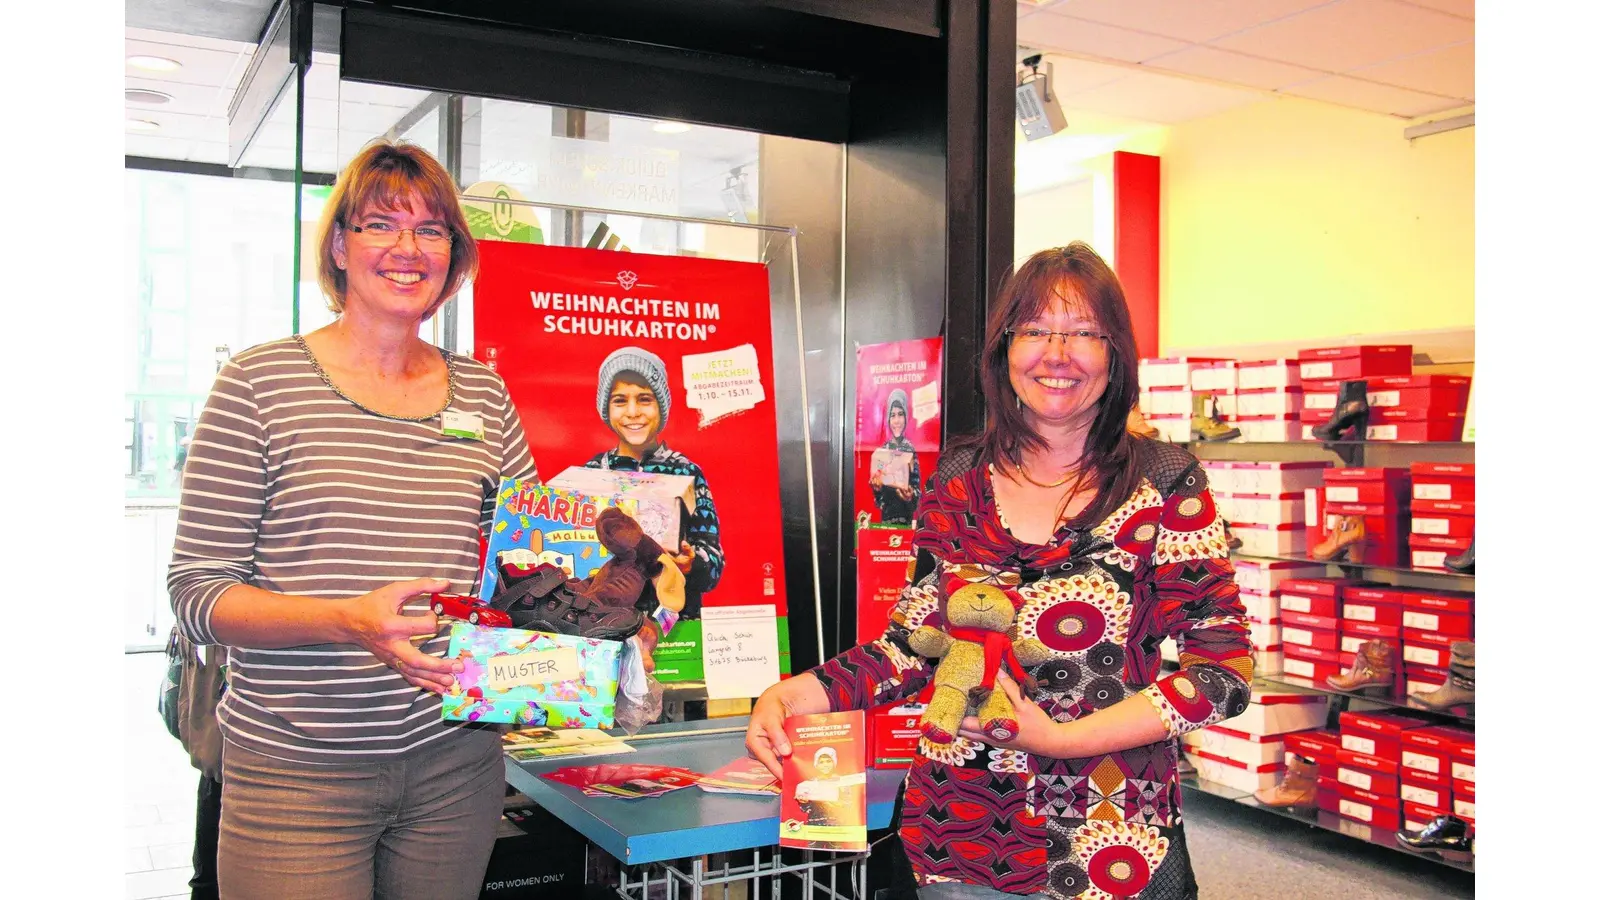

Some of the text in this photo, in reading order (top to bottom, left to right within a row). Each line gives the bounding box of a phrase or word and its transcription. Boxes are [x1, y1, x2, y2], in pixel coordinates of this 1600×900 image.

[530, 291, 721, 320] WEIHNACHTEN IM
[708, 360, 734, 369] JETZT
[870, 361, 917, 373] WEIHNACHTEN
[693, 379, 754, 390] ABGABEZEITRAUM
[728, 388, 753, 398] 15.11.
[516, 488, 598, 527] HARIB
[552, 531, 595, 541] Malbu
[494, 659, 559, 681] MUSTER
[486, 873, 565, 891] FOR WOMEN ONLY
